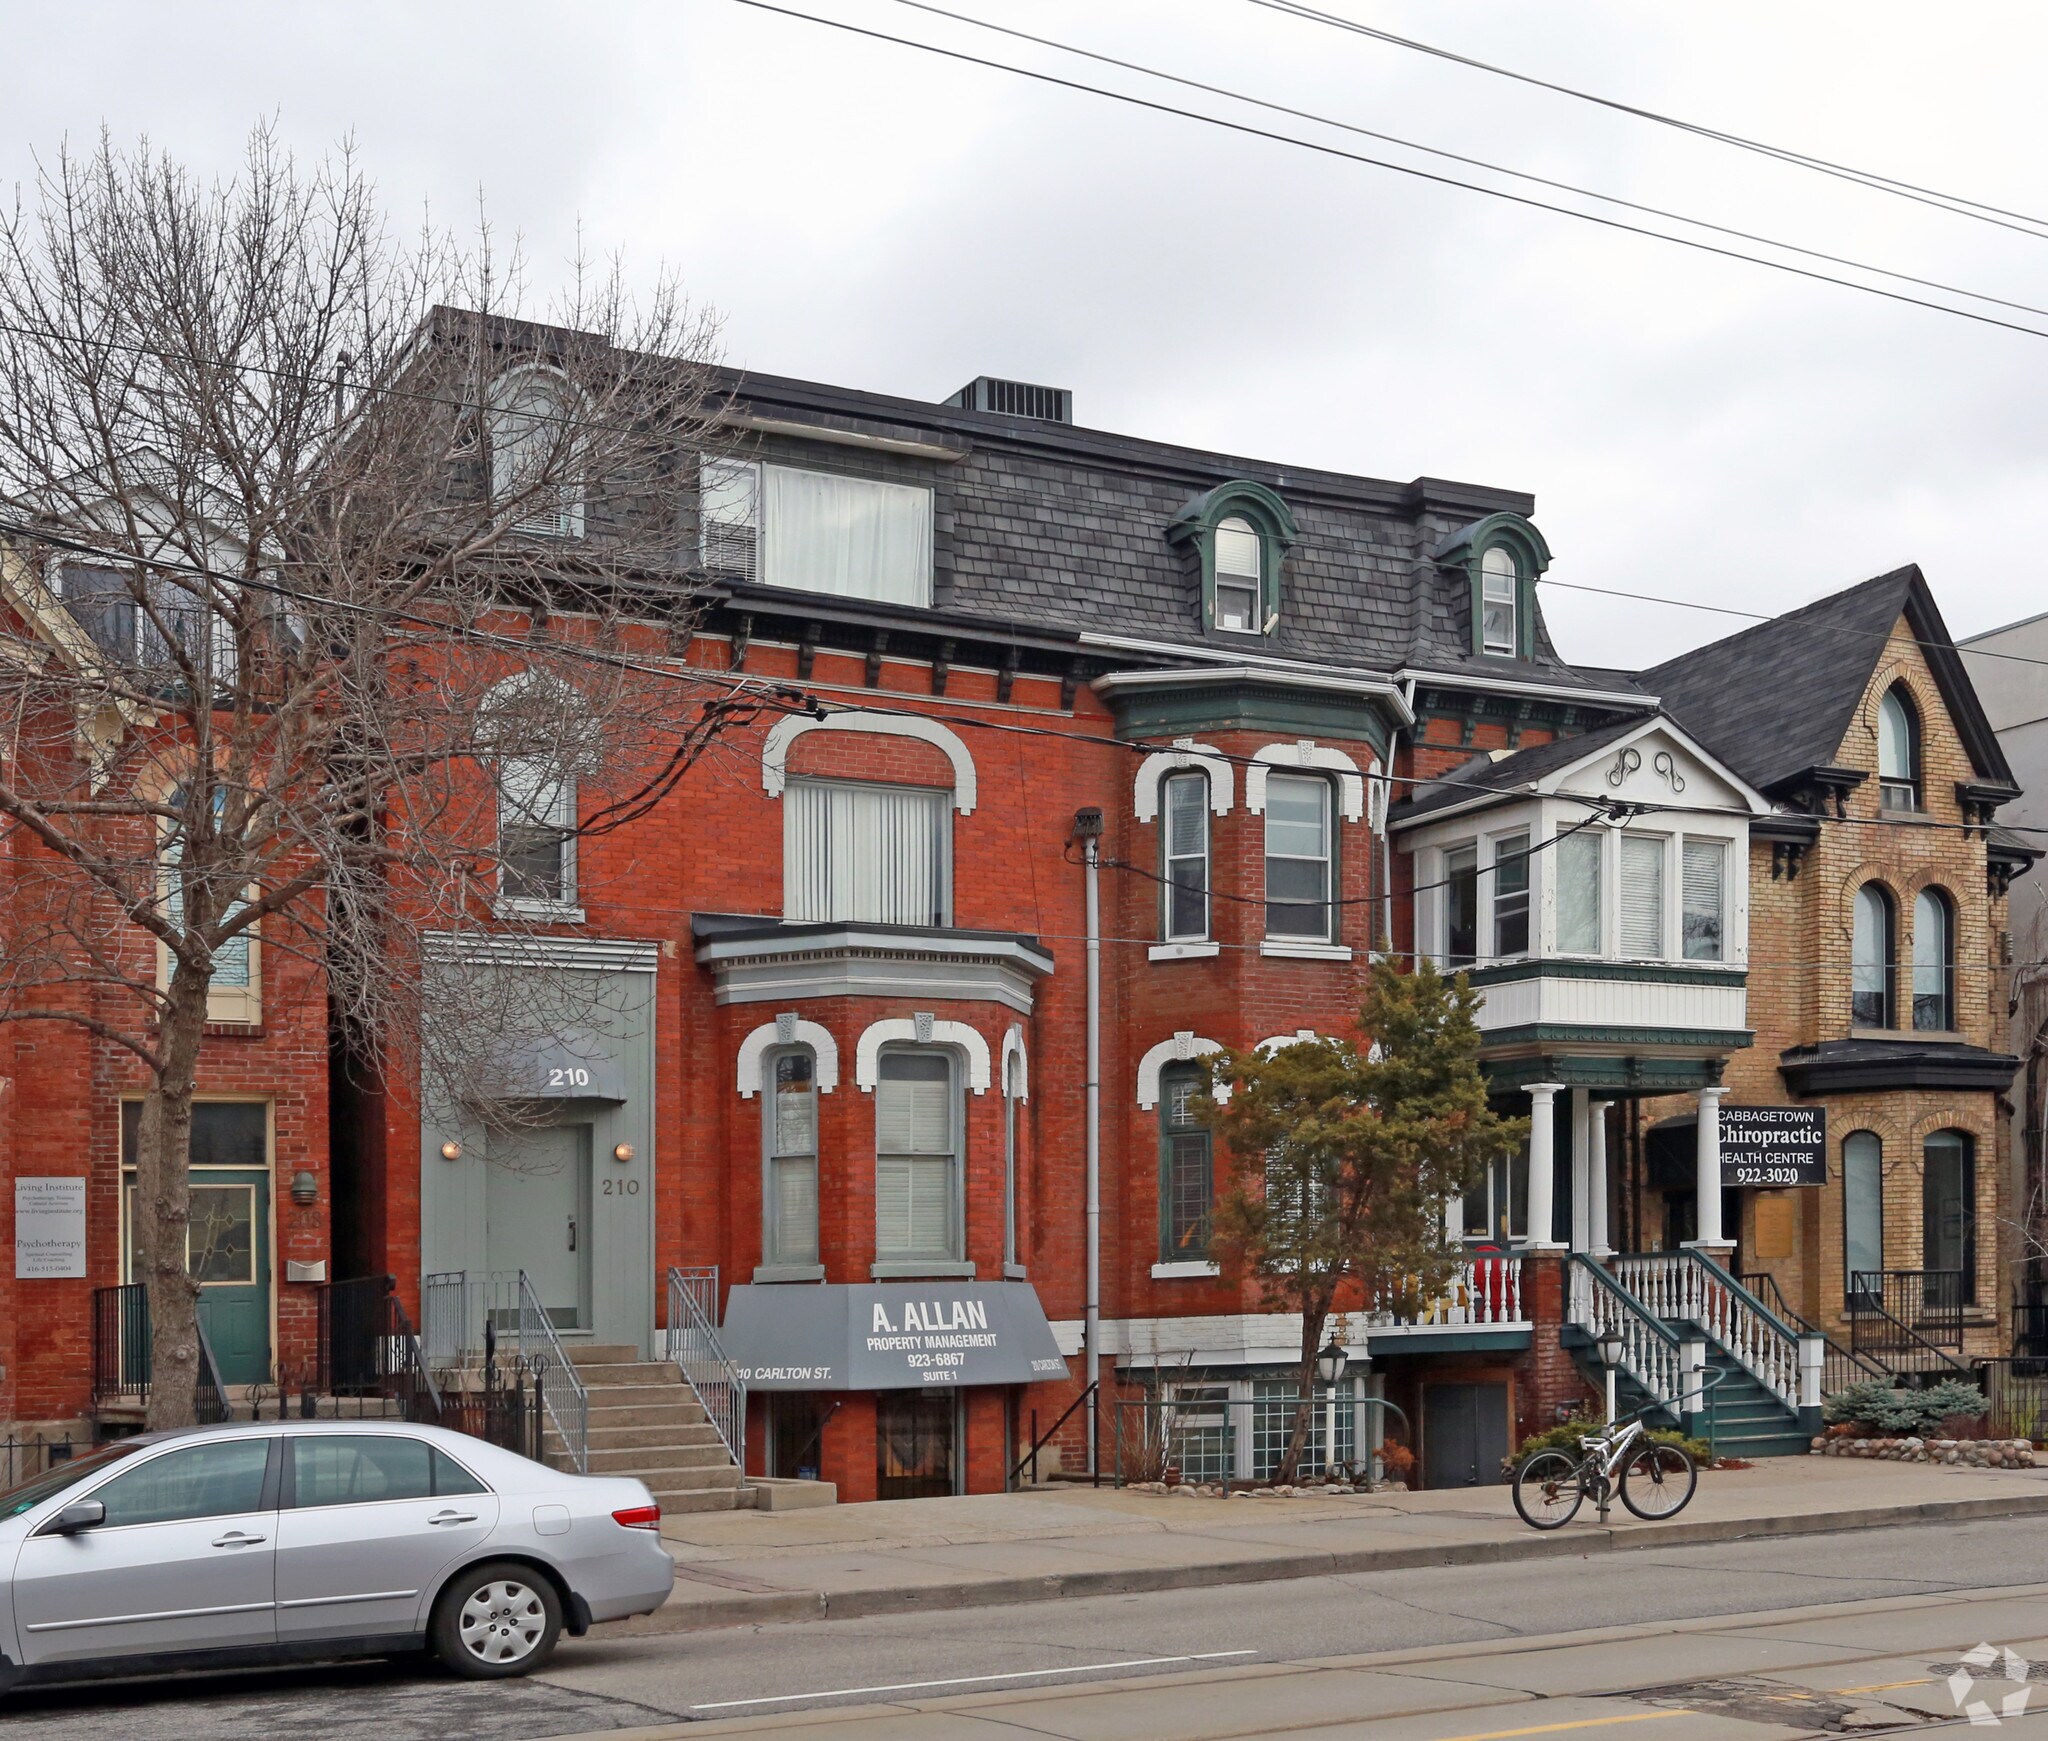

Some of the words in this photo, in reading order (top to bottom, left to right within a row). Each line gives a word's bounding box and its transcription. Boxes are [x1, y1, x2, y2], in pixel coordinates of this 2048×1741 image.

[549, 1068, 589, 1086] 210
[1718, 1110, 1814, 1123] CABBAGETOWN
[1719, 1124, 1822, 1148] Chiropractic
[1765, 1152, 1814, 1164] CENTRE
[1737, 1168, 1798, 1183] 922-3020
[45, 1183, 84, 1191] Institute
[602, 1179, 640, 1195] 210
[17, 1240, 81, 1248] Psychotherapy
[873, 1303, 898, 1333] A.
[904, 1300, 988, 1331] ALLAN
[866, 1336, 921, 1351] PROPERTY
[924, 1333, 997, 1349] MANAGEMENT
[907, 1352, 965, 1367] 923-6867
[737, 1367, 751, 1380] 10
[755, 1366, 812, 1380] CARLTON
[814, 1367, 832, 1379] ST.
[922, 1371, 951, 1381] SUITE
[952, 1370, 958, 1380] 1
